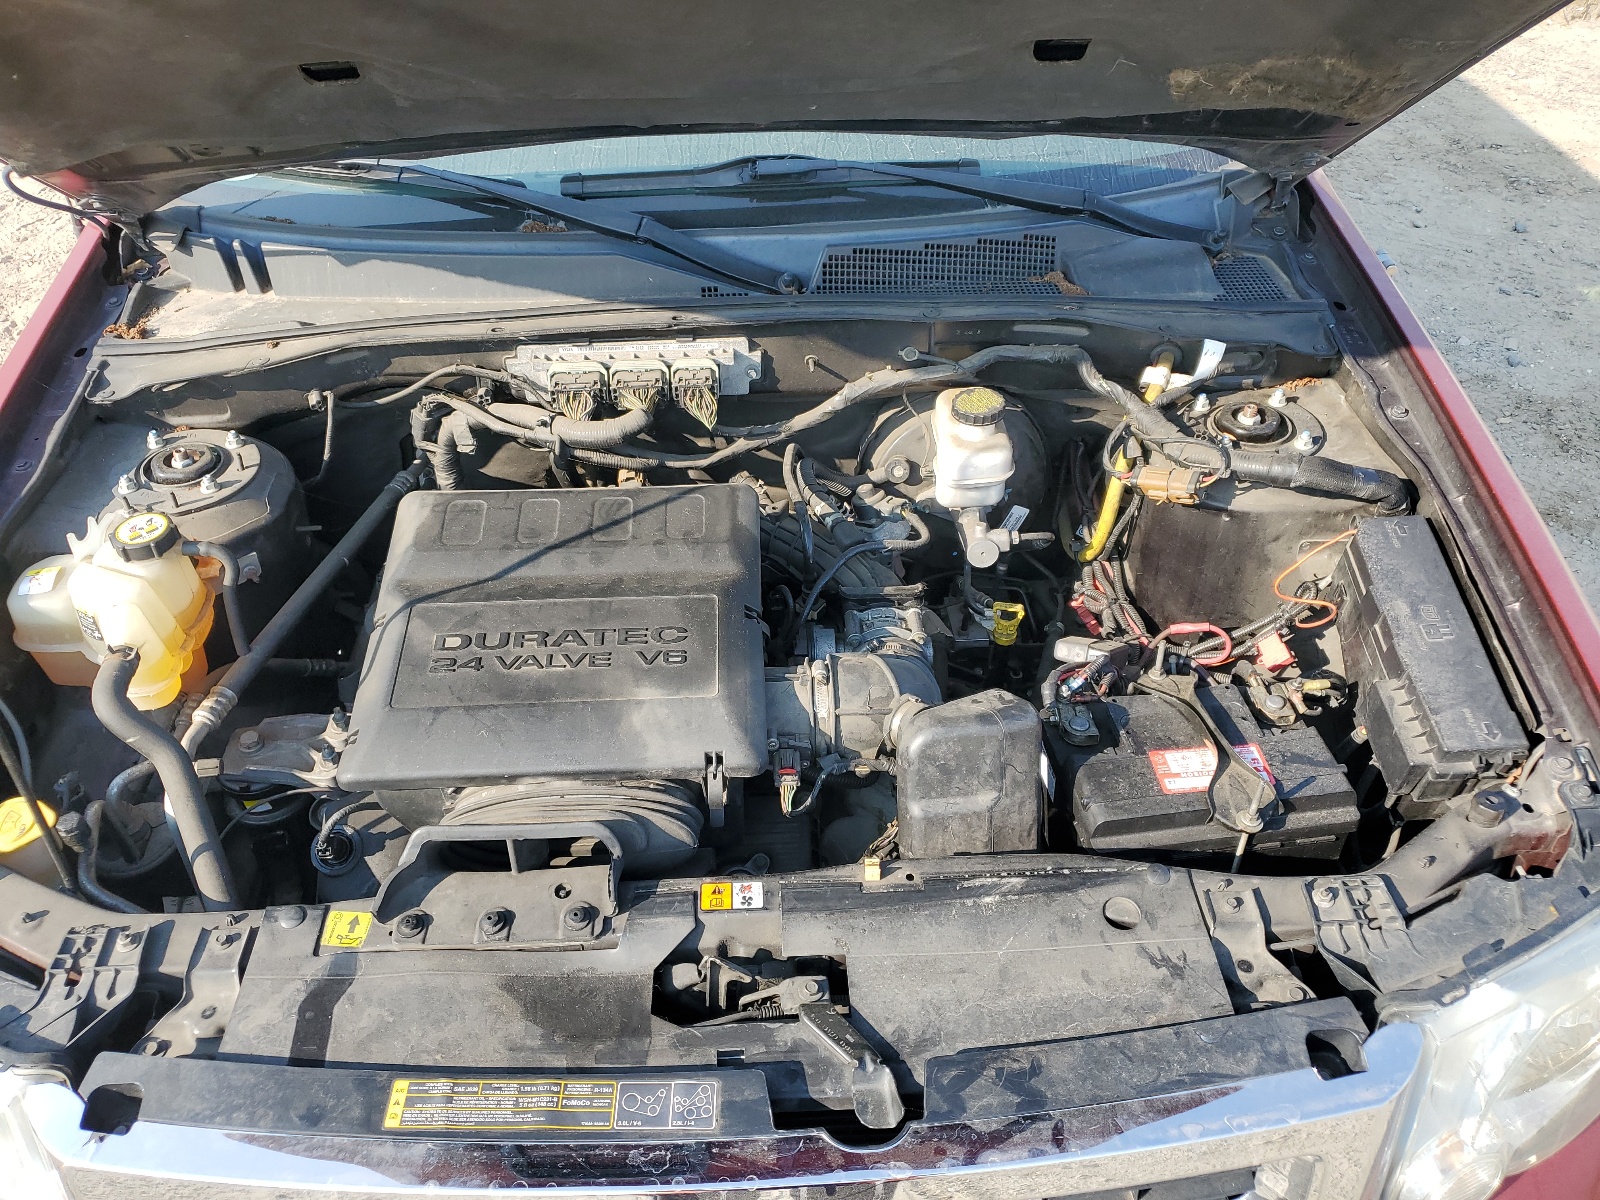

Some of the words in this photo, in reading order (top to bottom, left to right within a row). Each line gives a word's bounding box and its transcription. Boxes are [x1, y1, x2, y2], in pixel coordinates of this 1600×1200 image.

[433, 626, 689, 651] DURATEC
[428, 656, 485, 674] 24
[495, 651, 613, 670] VALVE
[634, 650, 688, 666] V6
